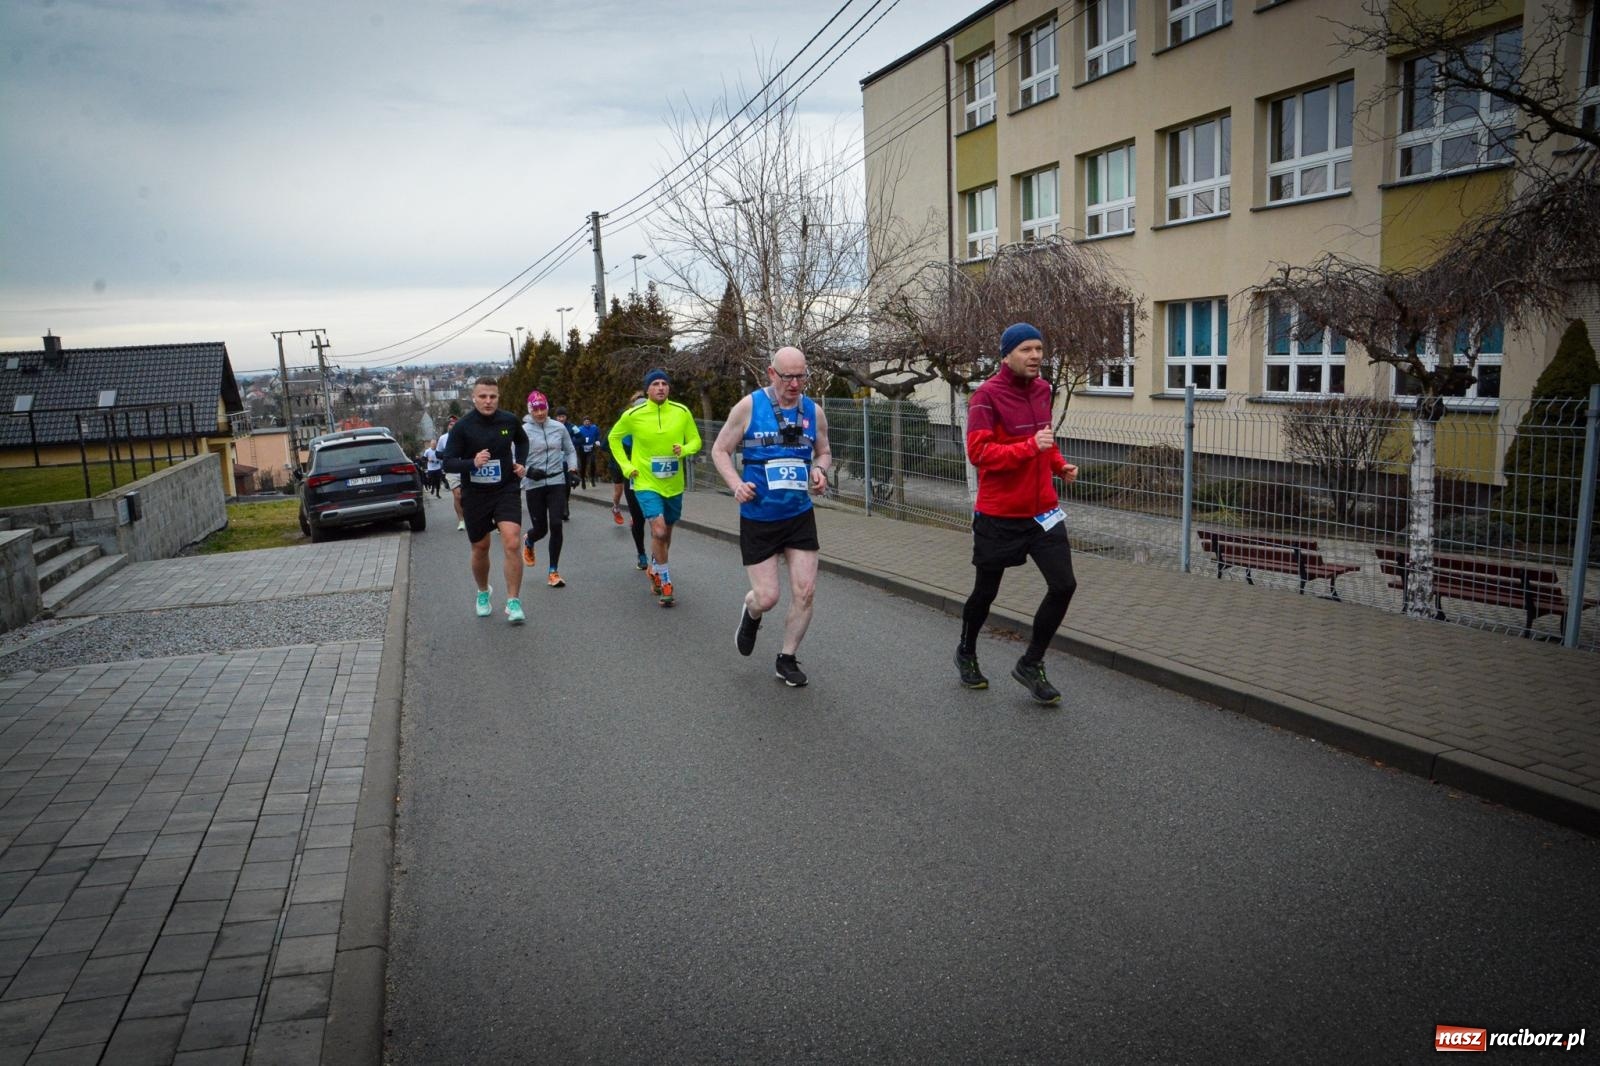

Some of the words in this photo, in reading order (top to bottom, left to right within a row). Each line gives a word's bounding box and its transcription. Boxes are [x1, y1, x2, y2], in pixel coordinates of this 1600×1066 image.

[475, 466, 495, 476] 205
[659, 462, 672, 472] 75
[779, 467, 797, 480] 95
